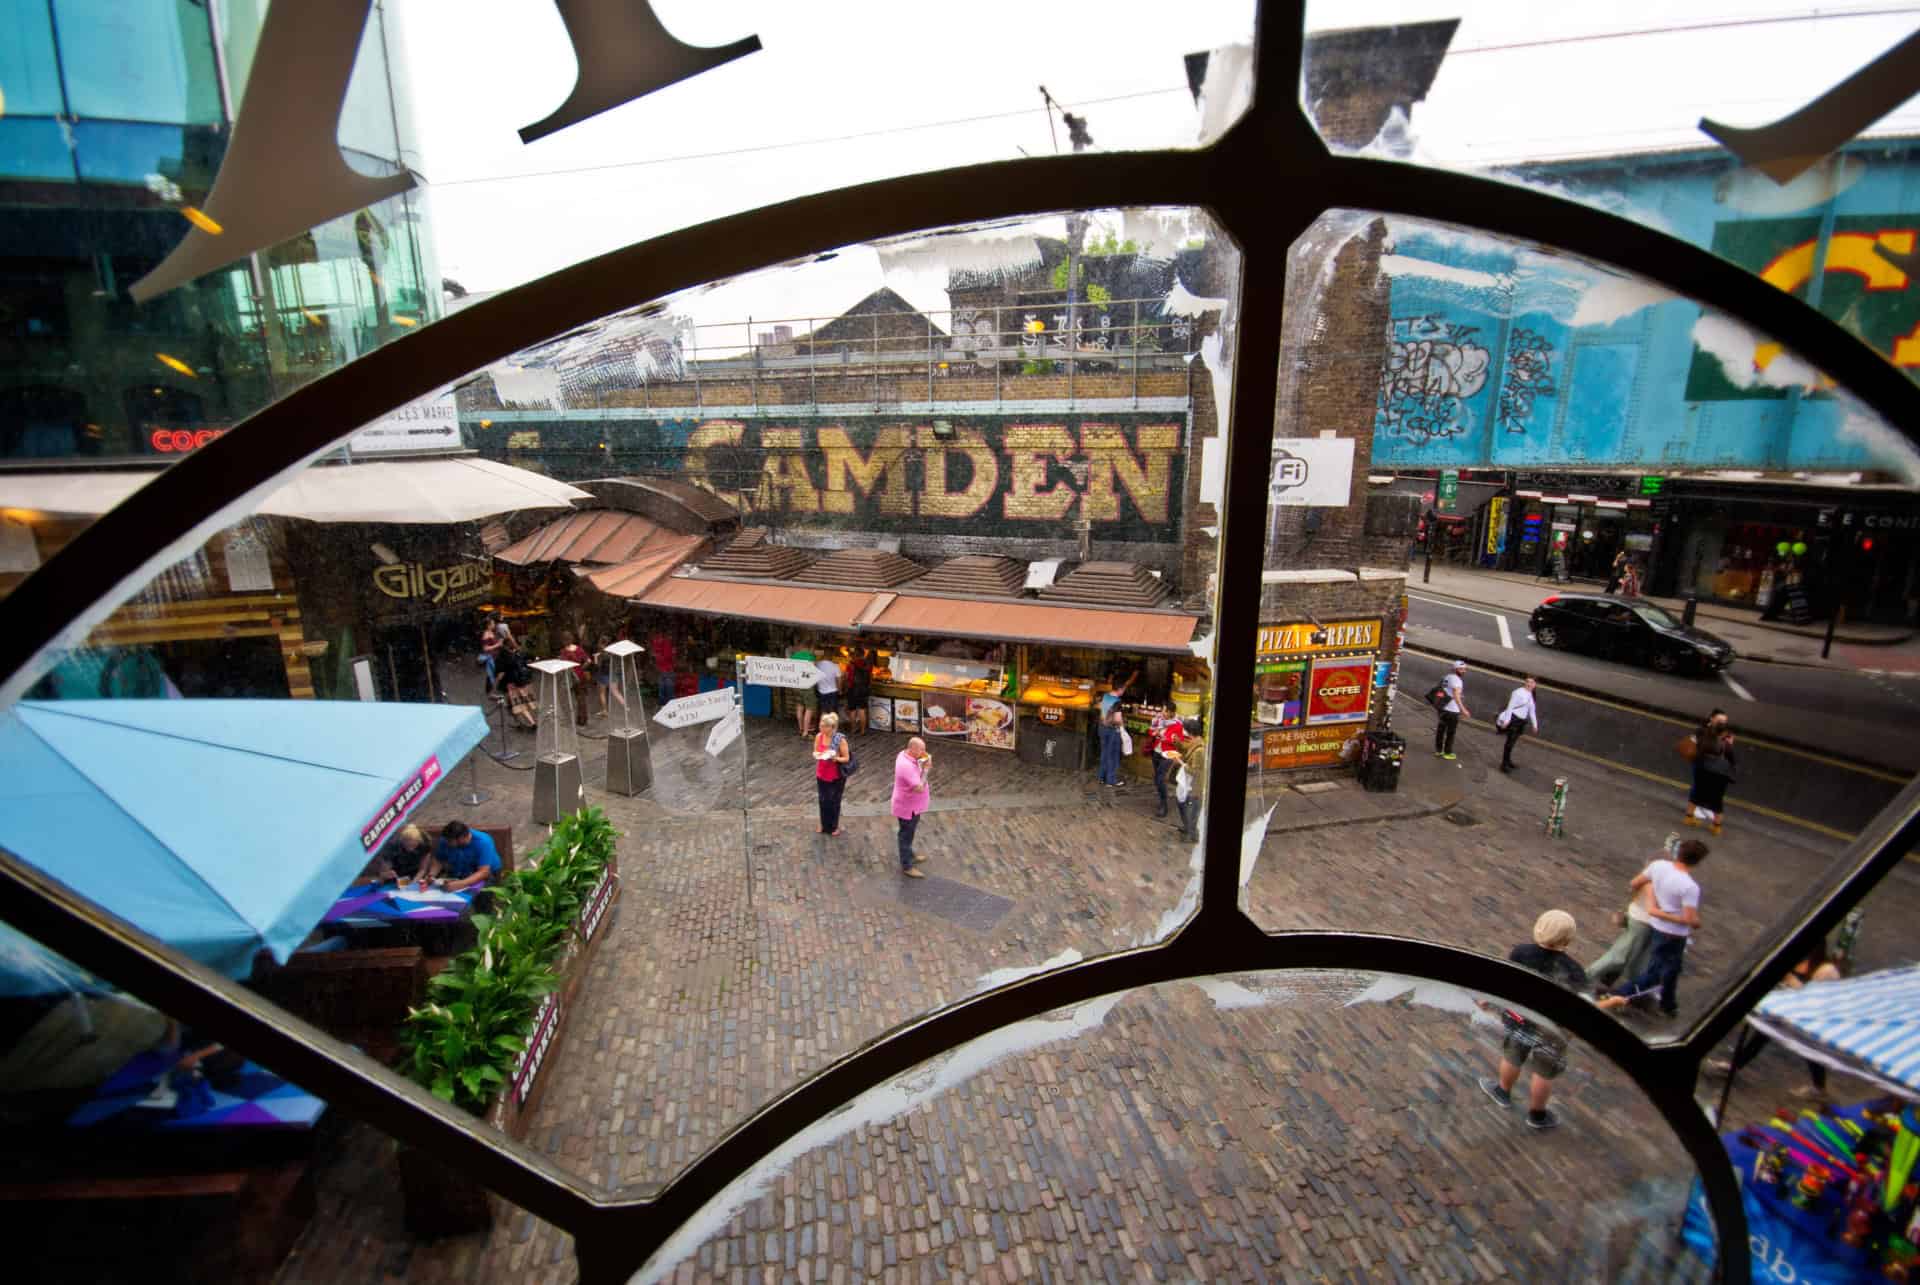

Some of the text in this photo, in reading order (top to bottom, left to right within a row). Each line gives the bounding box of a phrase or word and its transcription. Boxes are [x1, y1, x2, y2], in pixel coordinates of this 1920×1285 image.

[685, 418, 1182, 525] CAMDEN
[1257, 628, 1301, 651] PIZZA
[1322, 623, 1372, 647] REPES
[1319, 685, 1361, 697] COFFEE
[363, 805, 396, 848] CAMDEN
